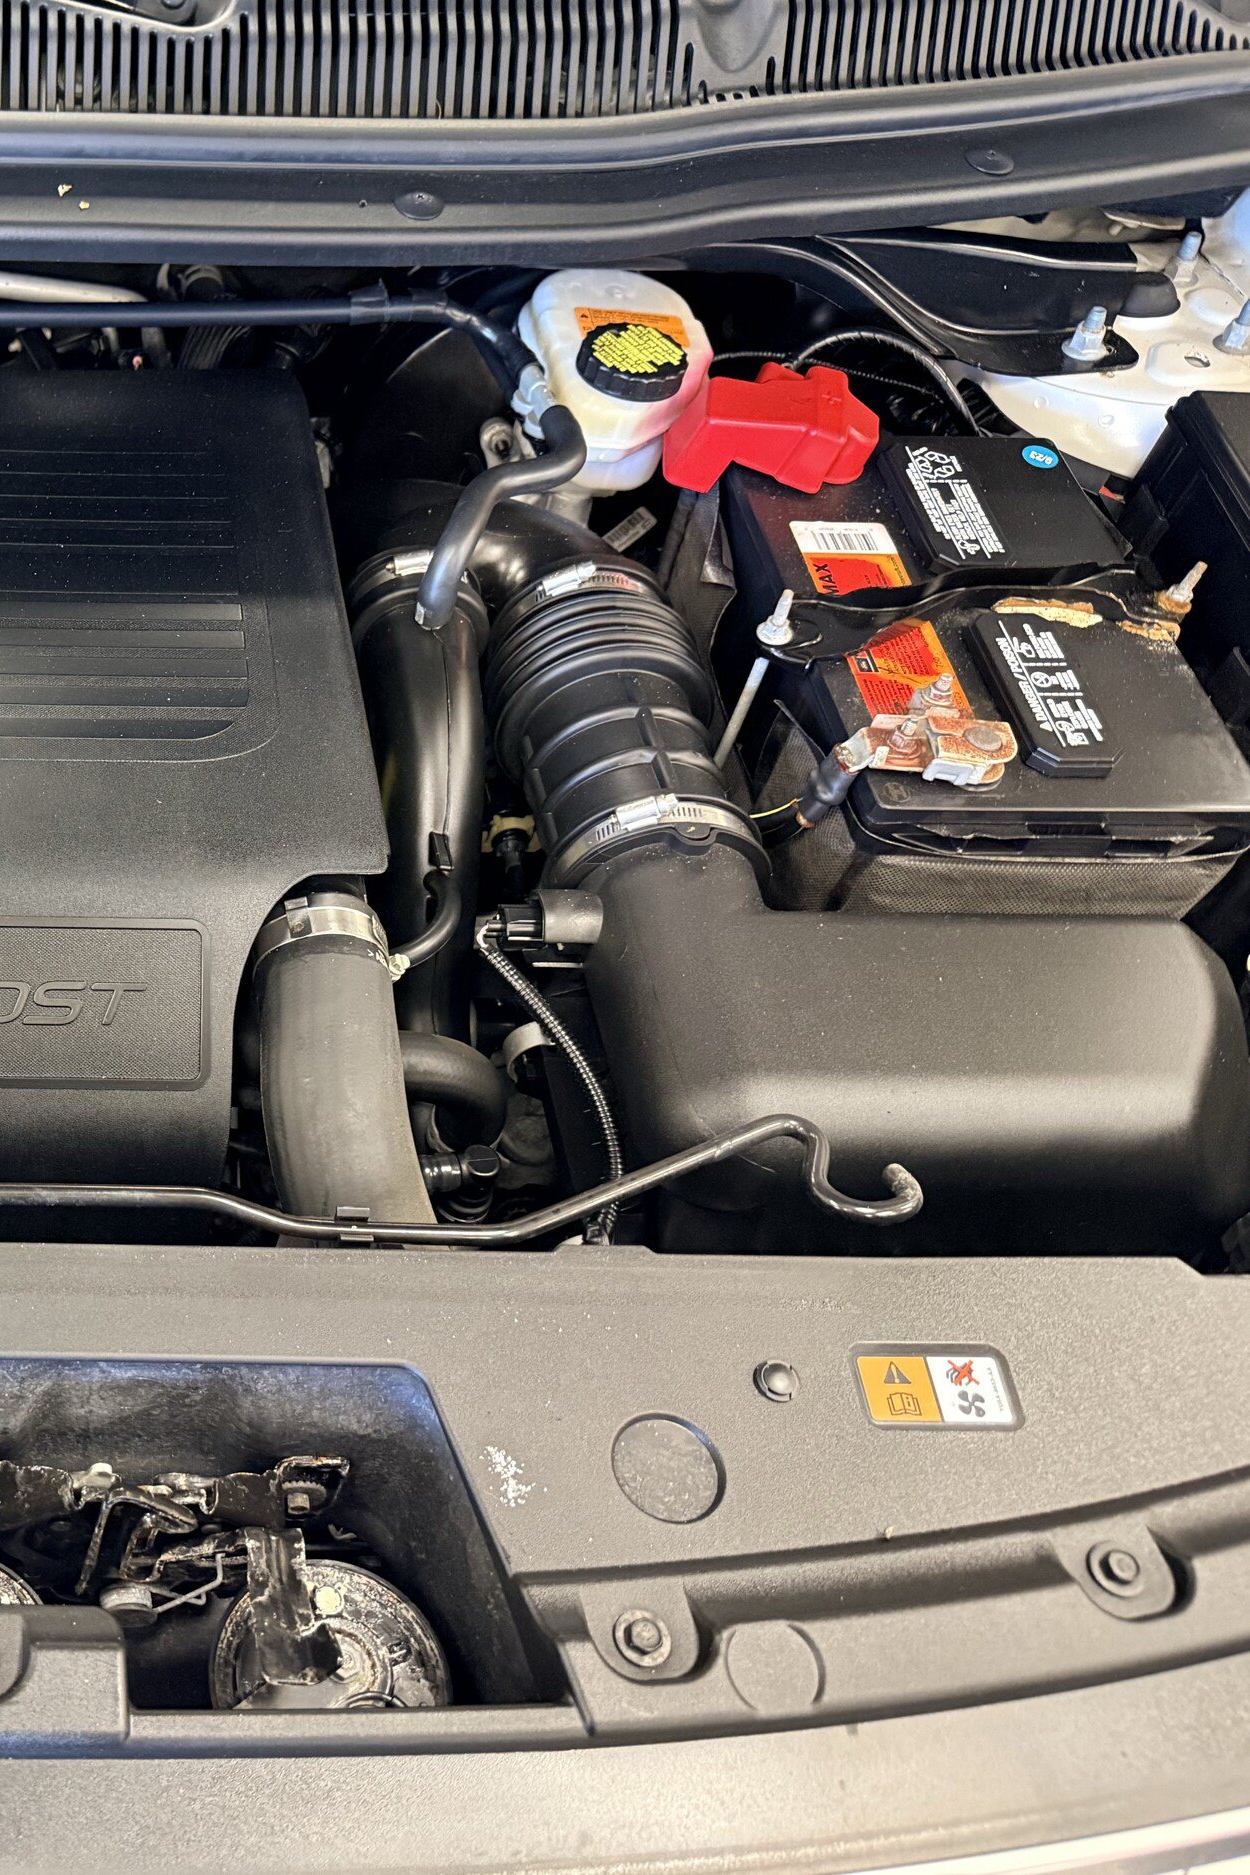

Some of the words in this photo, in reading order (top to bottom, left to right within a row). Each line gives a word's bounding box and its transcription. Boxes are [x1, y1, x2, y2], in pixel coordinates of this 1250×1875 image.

[813, 563, 839, 595] MAX
[995, 638, 1022, 672] POISON
[1018, 681, 1047, 720] DANGER
